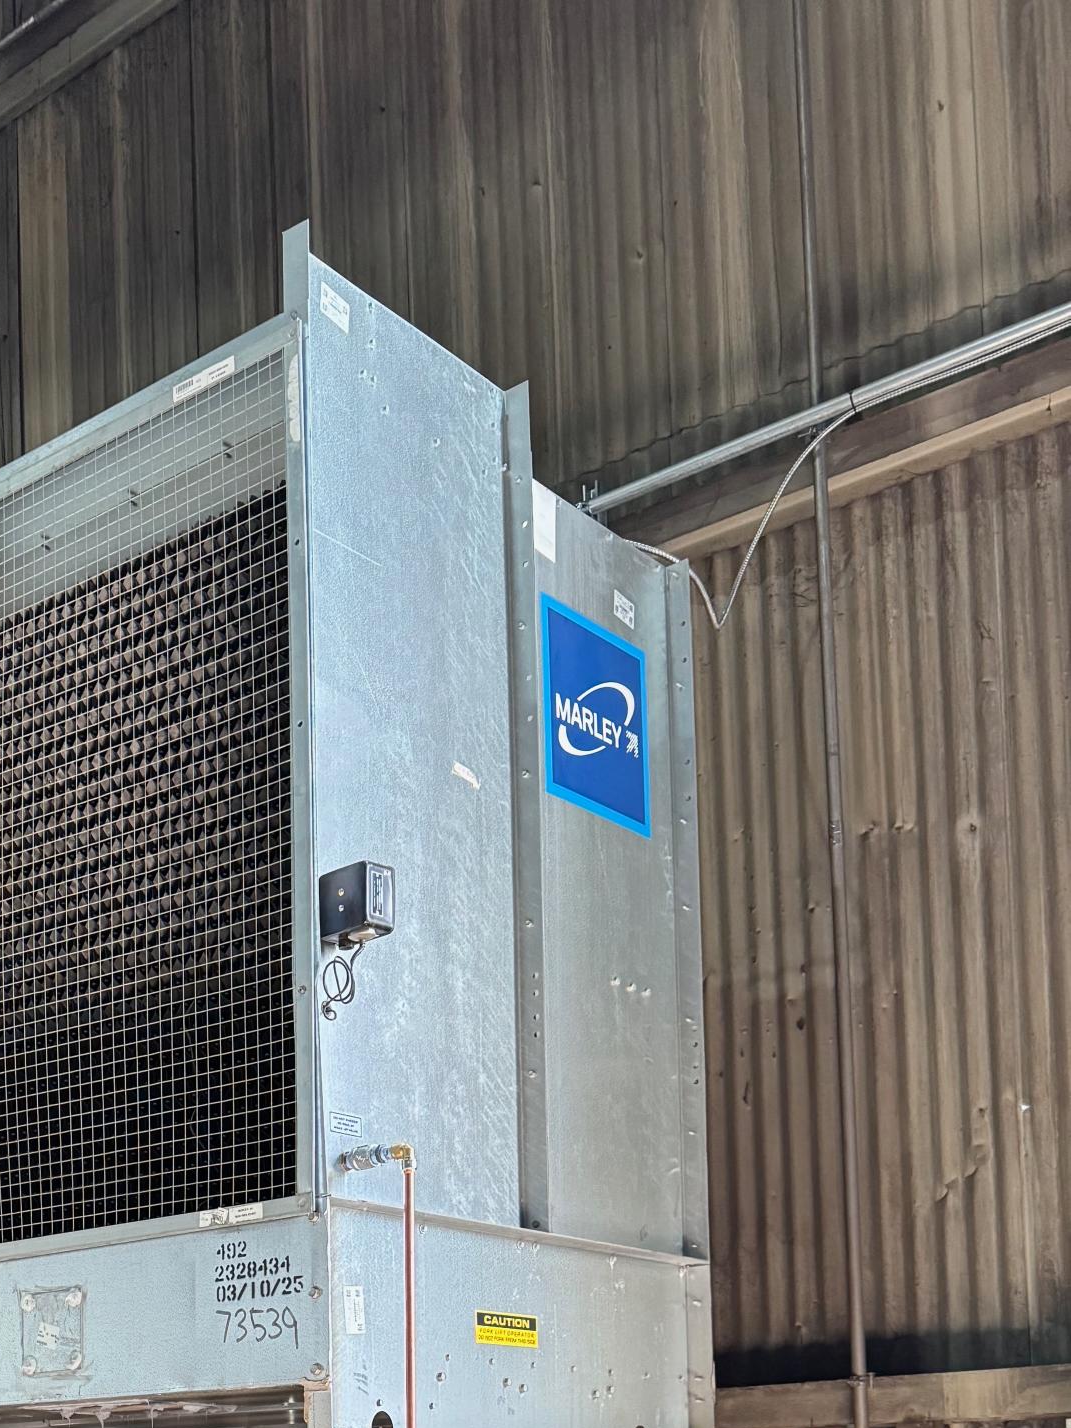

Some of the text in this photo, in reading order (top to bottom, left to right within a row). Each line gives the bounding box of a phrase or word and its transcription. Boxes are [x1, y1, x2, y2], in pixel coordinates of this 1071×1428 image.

[555, 692, 622, 749] MARLEY
[216, 1240, 247, 1260] 492
[215, 1255, 290, 1283] 2328434
[216, 1275, 304, 1303] 03/10/25
[215, 1306, 299, 1350] 73539
[483, 1314, 530, 1329] CAUTION
